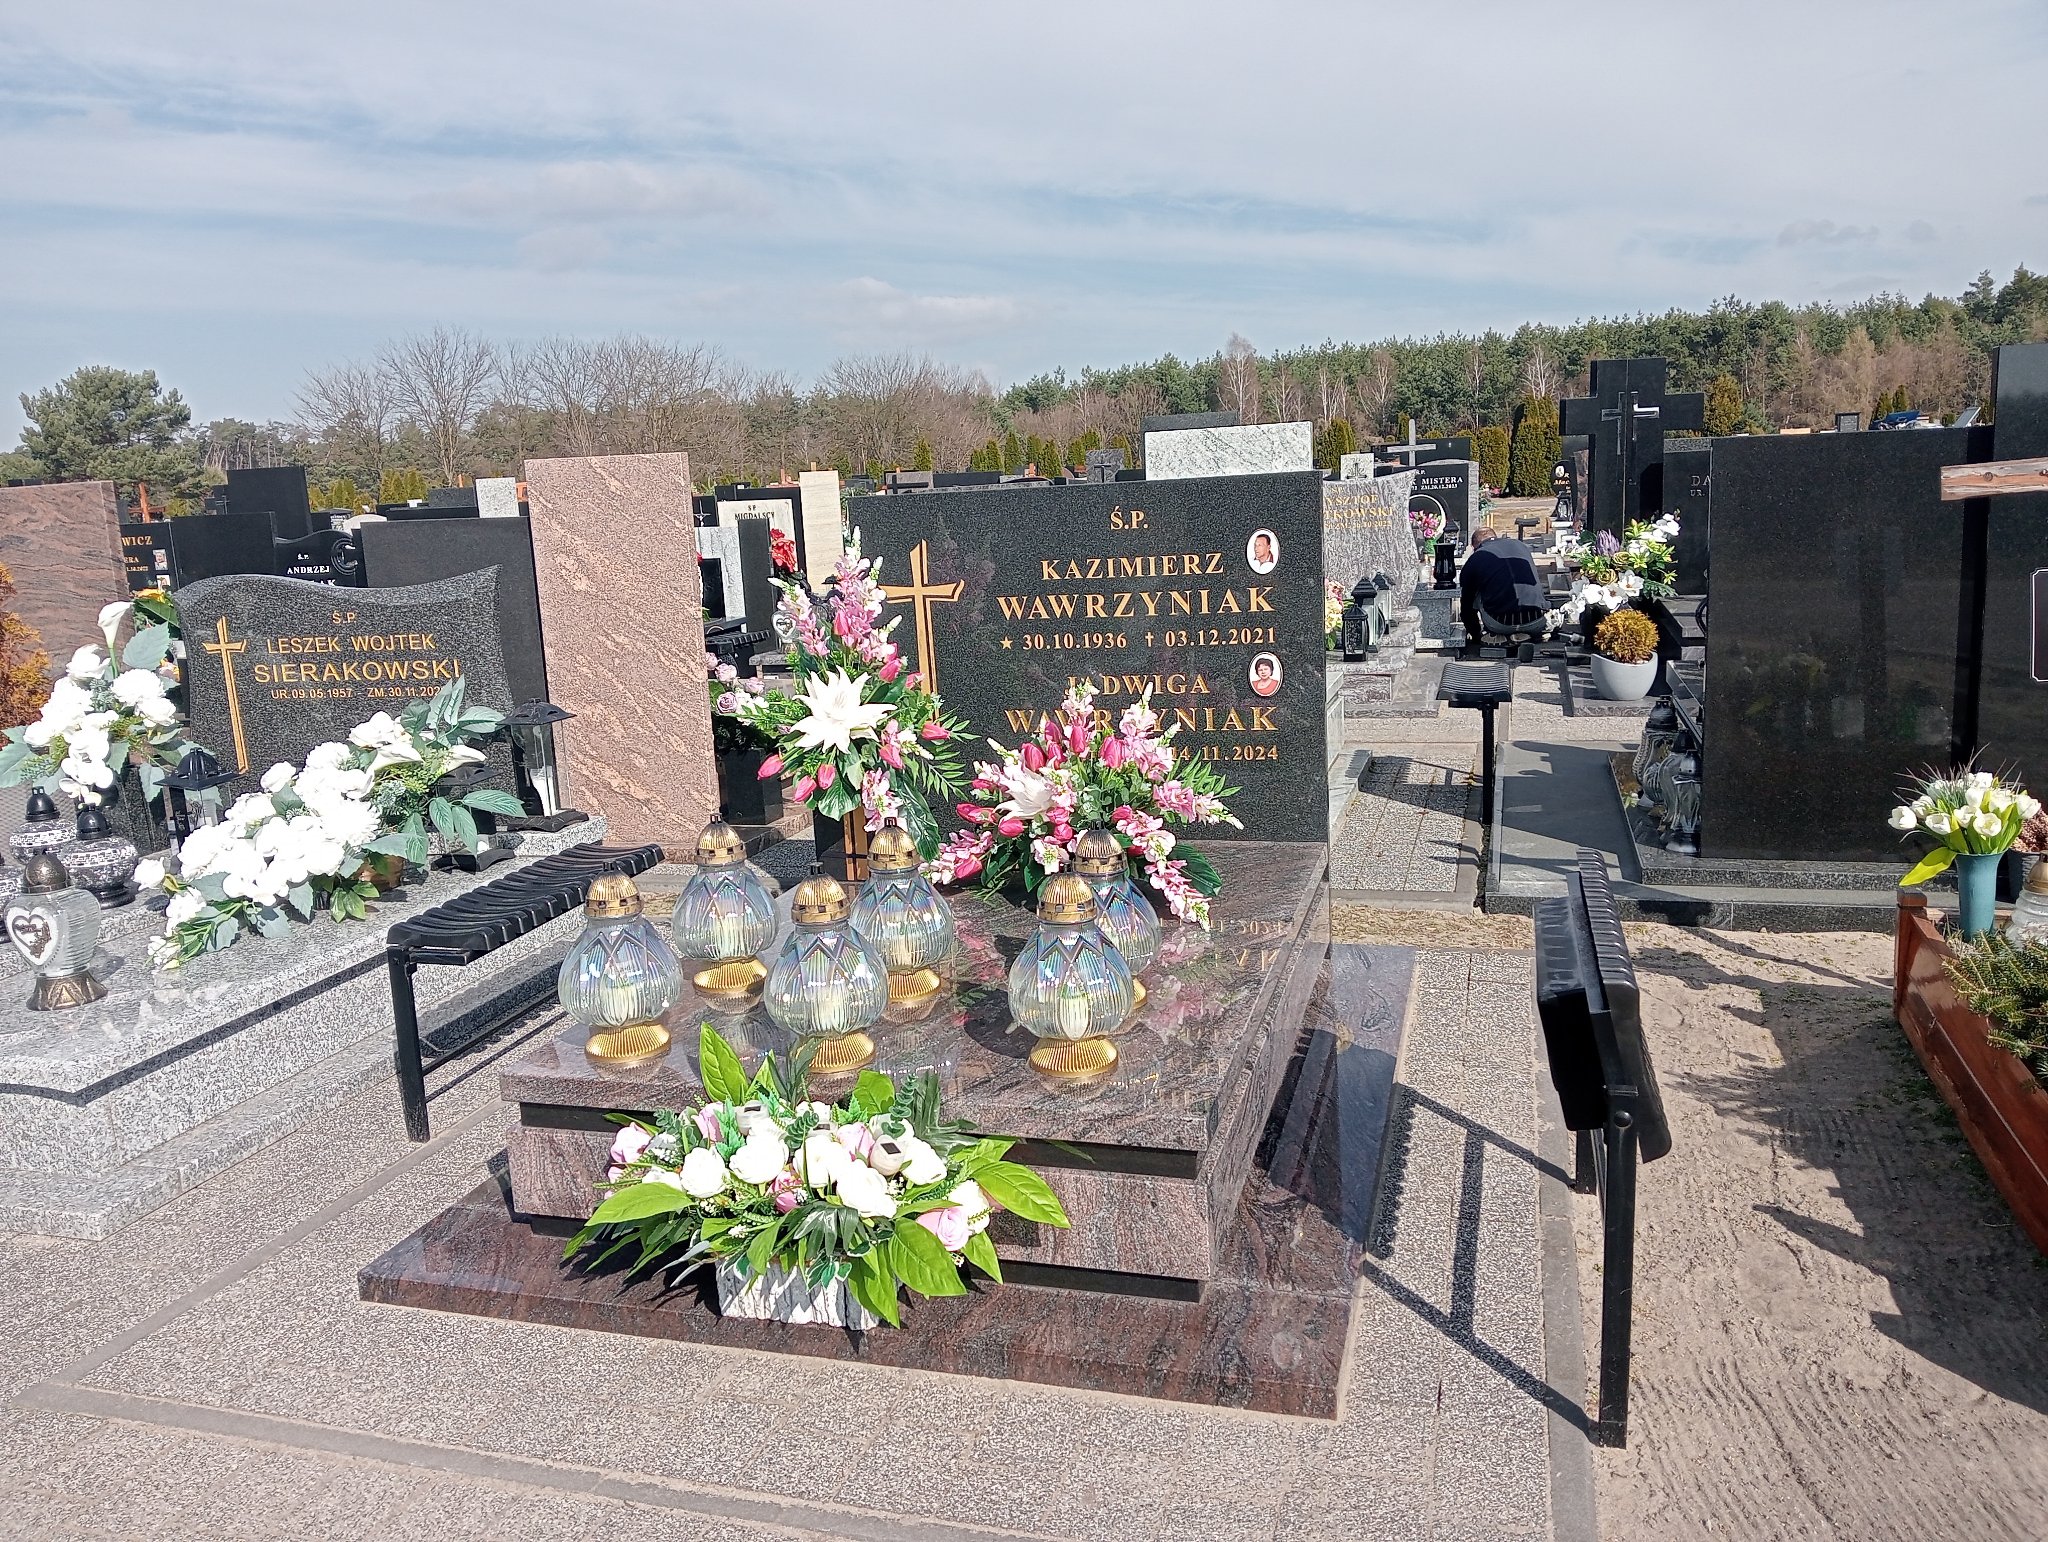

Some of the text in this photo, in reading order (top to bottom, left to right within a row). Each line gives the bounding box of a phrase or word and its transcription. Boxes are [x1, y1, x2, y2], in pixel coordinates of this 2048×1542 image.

[1421, 476, 1463, 485] MISTERA
[1109, 506, 1148, 531] Ś.P.
[286, 565, 331, 575] ANDRZEJ
[1040, 553, 1223, 580] KAZIMIERZ
[996, 586, 1275, 620] WAWRZYNIAK
[266, 633, 437, 655] LESZEK WOJTEK
[1021, 626, 1277, 651] 30.10.1936 03.12.2021
[254, 659, 461, 683] SIERAKOWSKI
[366, 685, 444, 698] ZM.30.11.202
